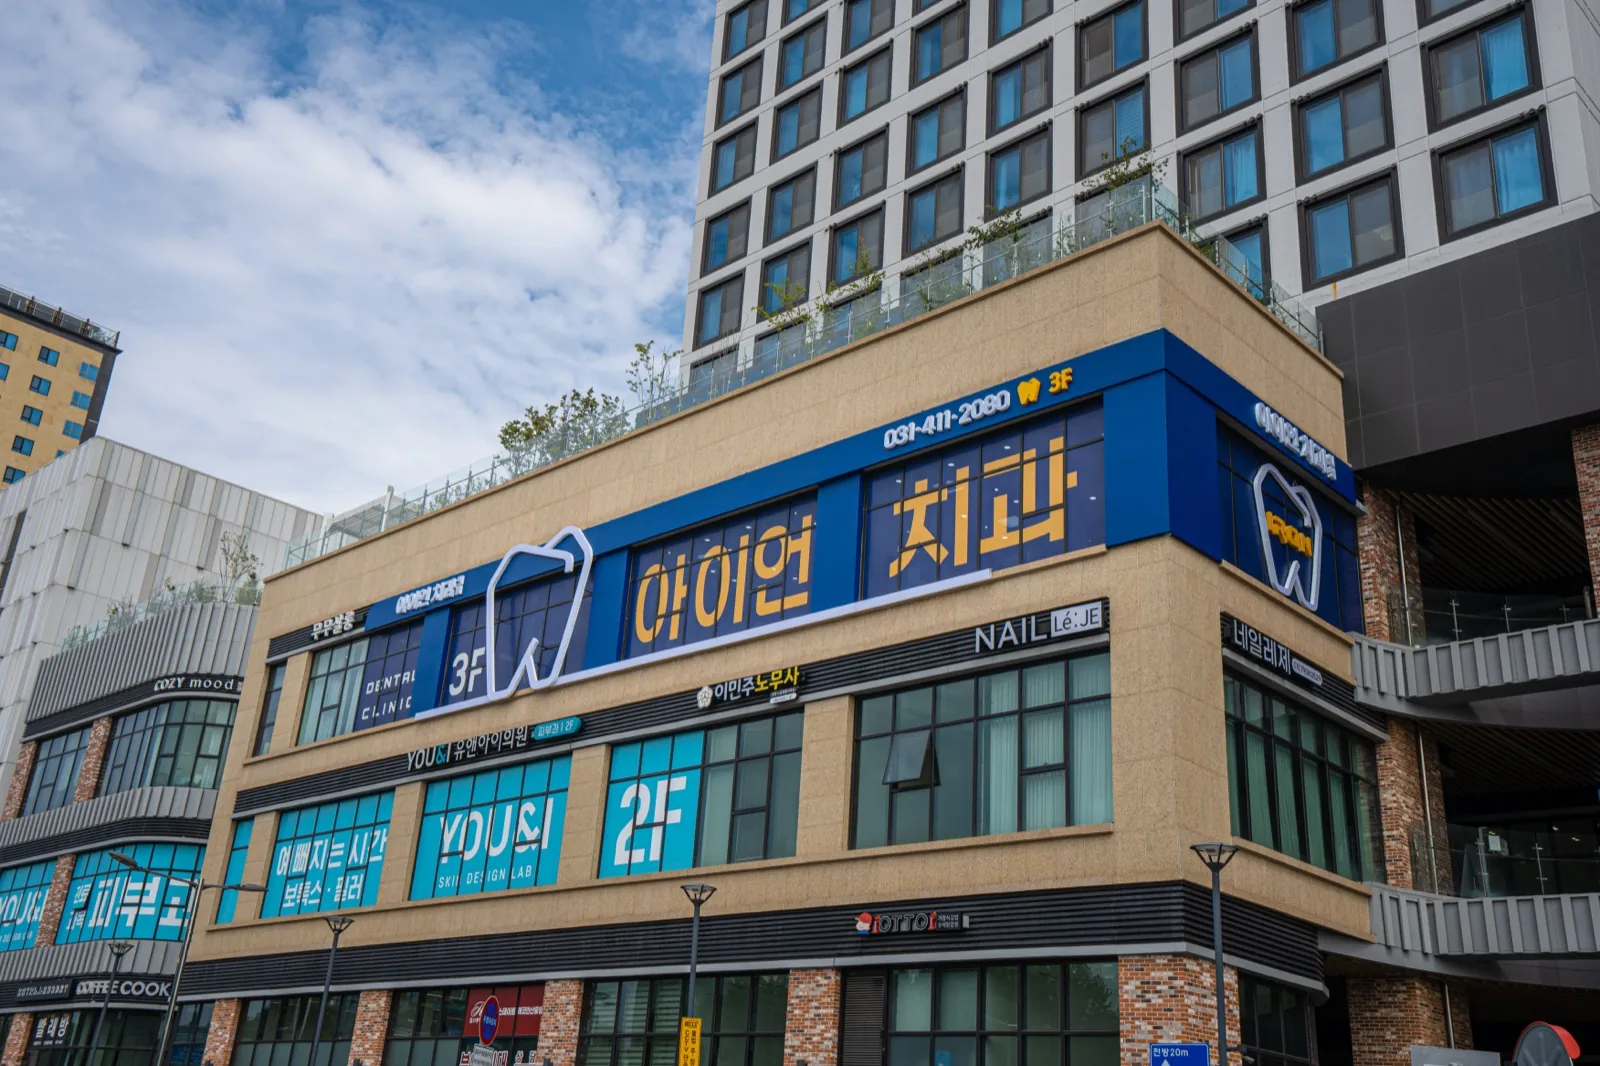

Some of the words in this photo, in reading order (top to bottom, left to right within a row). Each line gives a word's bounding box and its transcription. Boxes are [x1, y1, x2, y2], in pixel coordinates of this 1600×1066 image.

[884, 389, 1011, 449] 031-411-2080
[1048, 367, 1073, 393] 3F
[635, 514, 813, 644] 아이언
[888, 436, 1078, 578] 치과
[975, 615, 1048, 653] NAIL
[1233, 618, 1292, 676] 네일레제
[189, 679, 234, 690] mood
[366, 669, 416, 695] DENTAL
[448, 646, 486, 697] 3F
[361, 696, 412, 720] CLINIC
[407, 741, 452, 771] YOU&I
[440, 797, 554, 864] YOU&I
[614, 776, 687, 866] 2F
[347, 828, 388, 865] 시간
[333, 874, 364, 902] 필러
[466, 868, 506, 885] DESIGN
[510, 865, 532, 879] LAB
[120, 981, 172, 996] COOK
